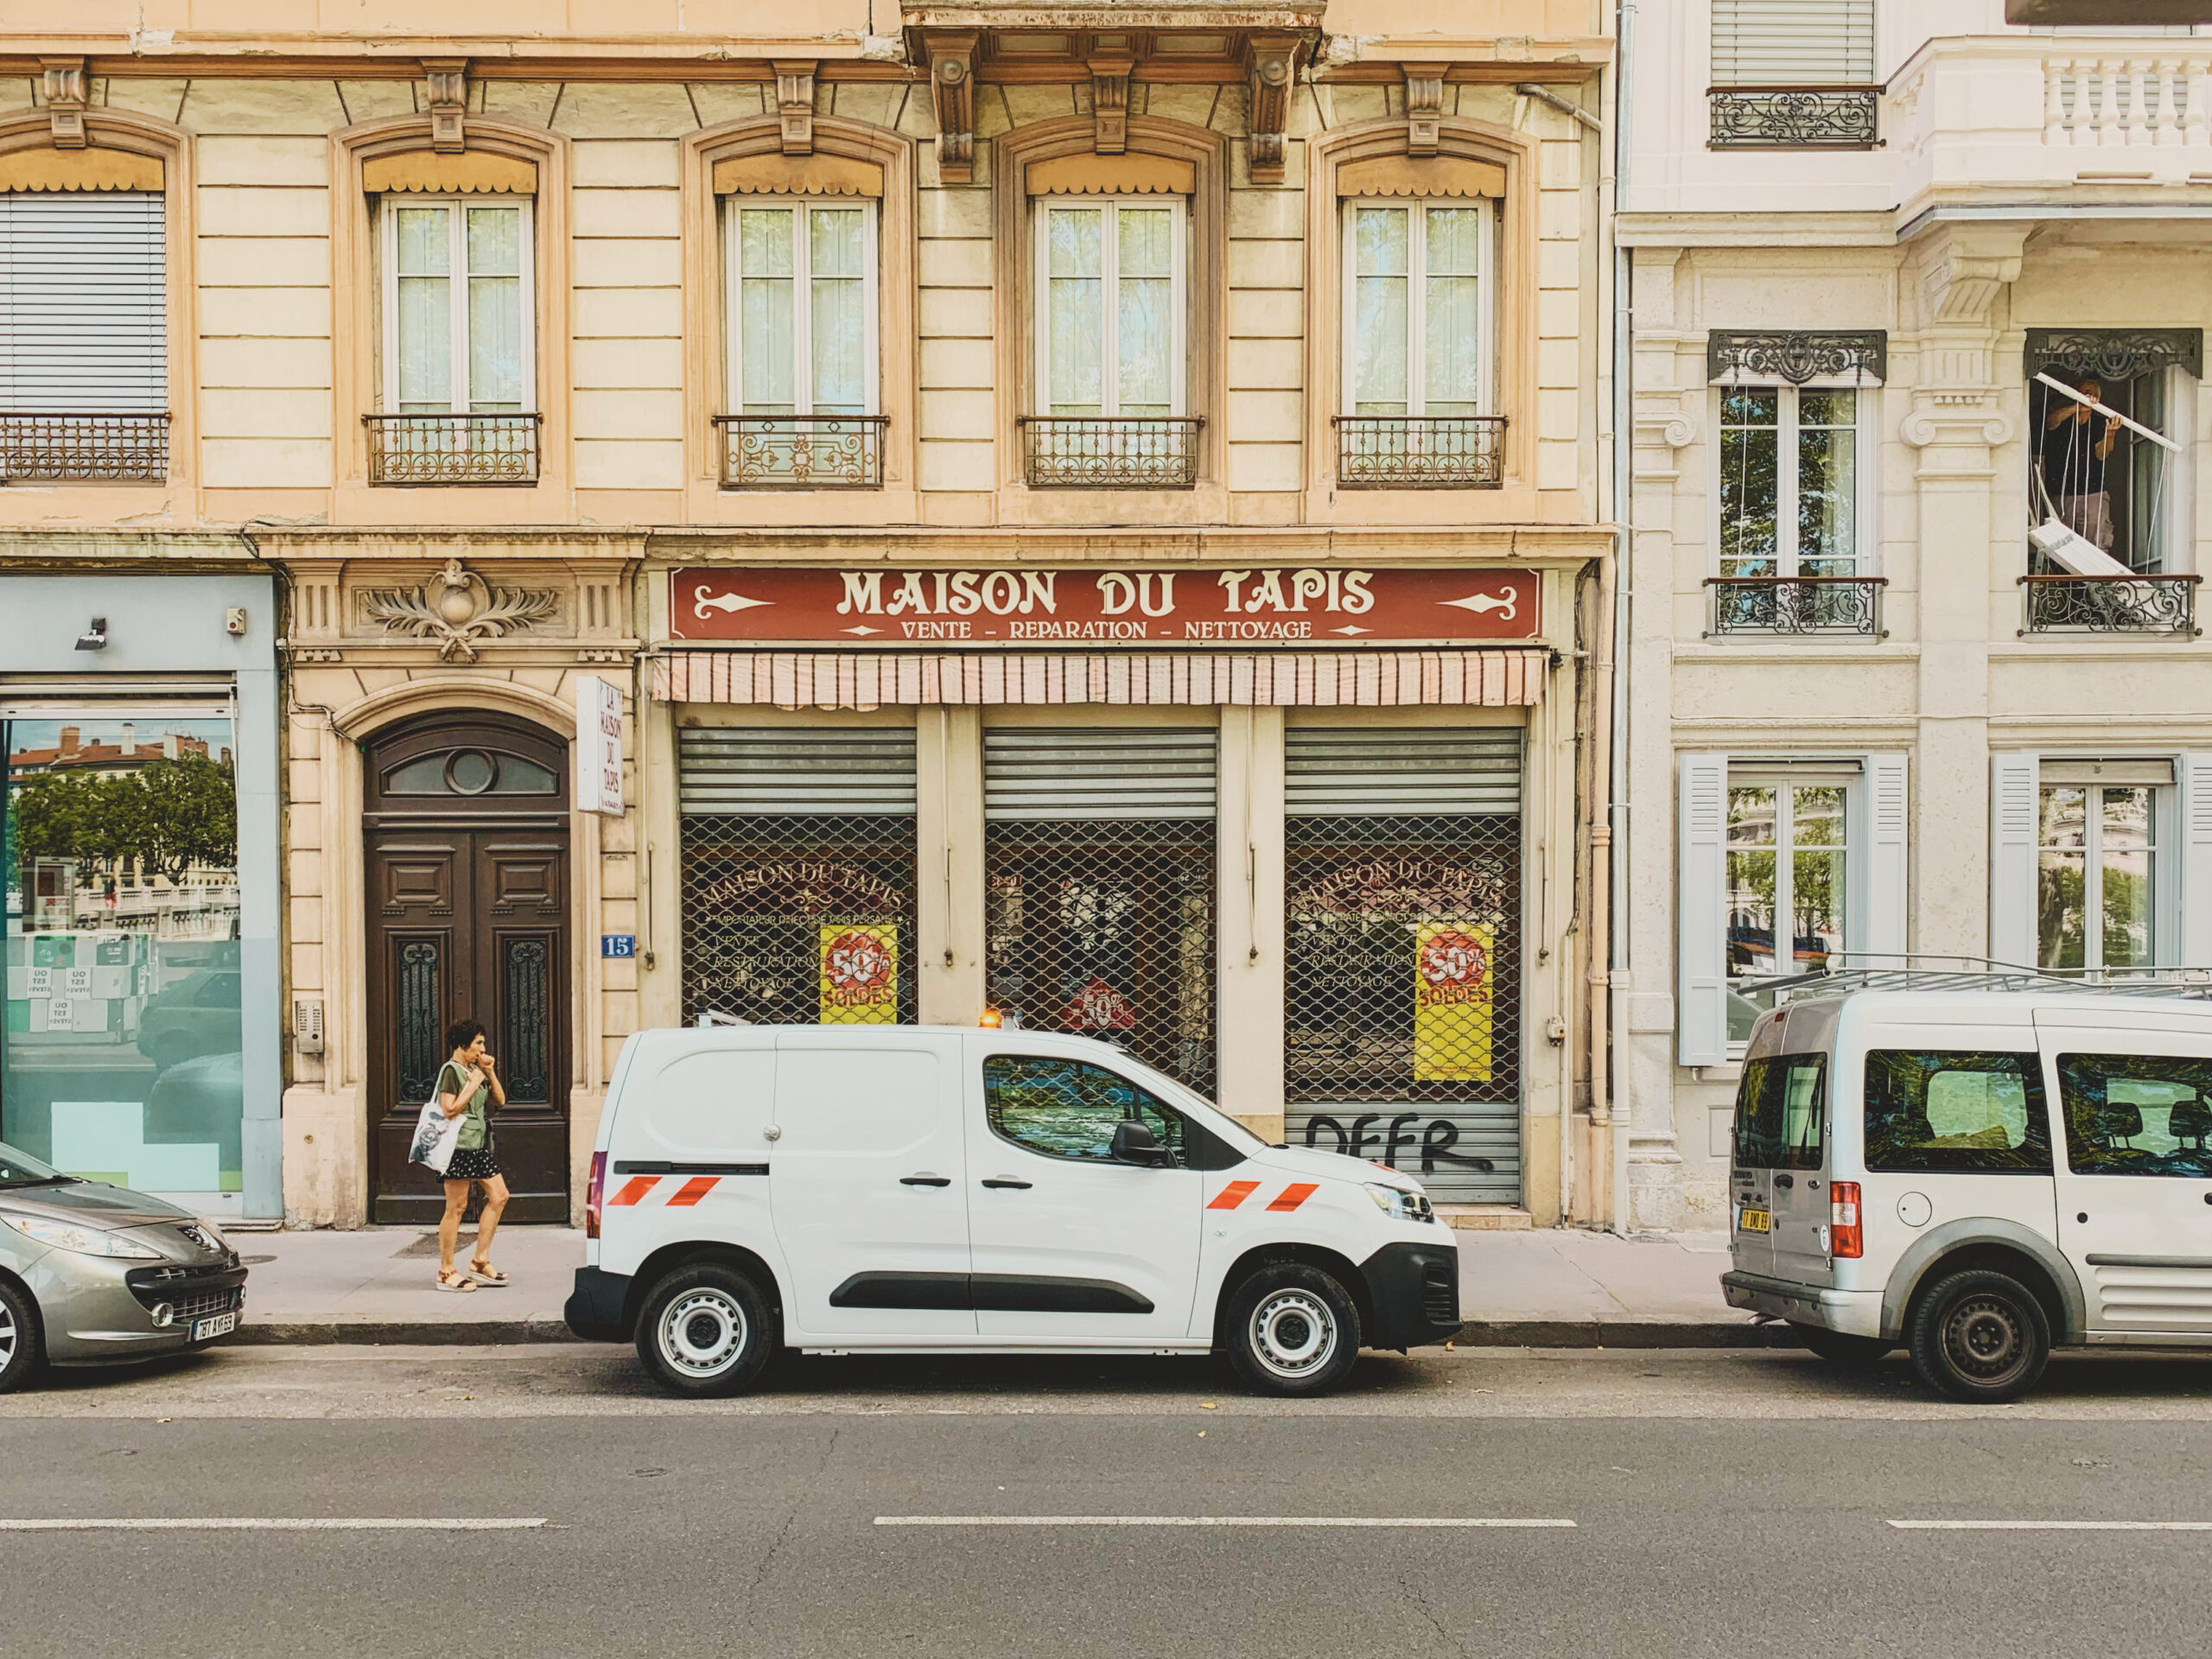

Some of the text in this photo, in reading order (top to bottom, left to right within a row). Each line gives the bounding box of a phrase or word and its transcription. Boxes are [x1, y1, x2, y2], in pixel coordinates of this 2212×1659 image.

[836, 569, 1375, 617] MAISON DU TAPIS
[901, 621, 971, 639] VENTE
[1009, 621, 1147, 639] REPARATION
[1185, 621, 1312, 639] NETTOYAGE
[607, 686, 614, 710] LA
[601, 710, 621, 740] MAISON
[604, 768, 619, 793] TAPIS
[702, 863, 794, 909] MAISON
[607, 938, 629, 956] 15
